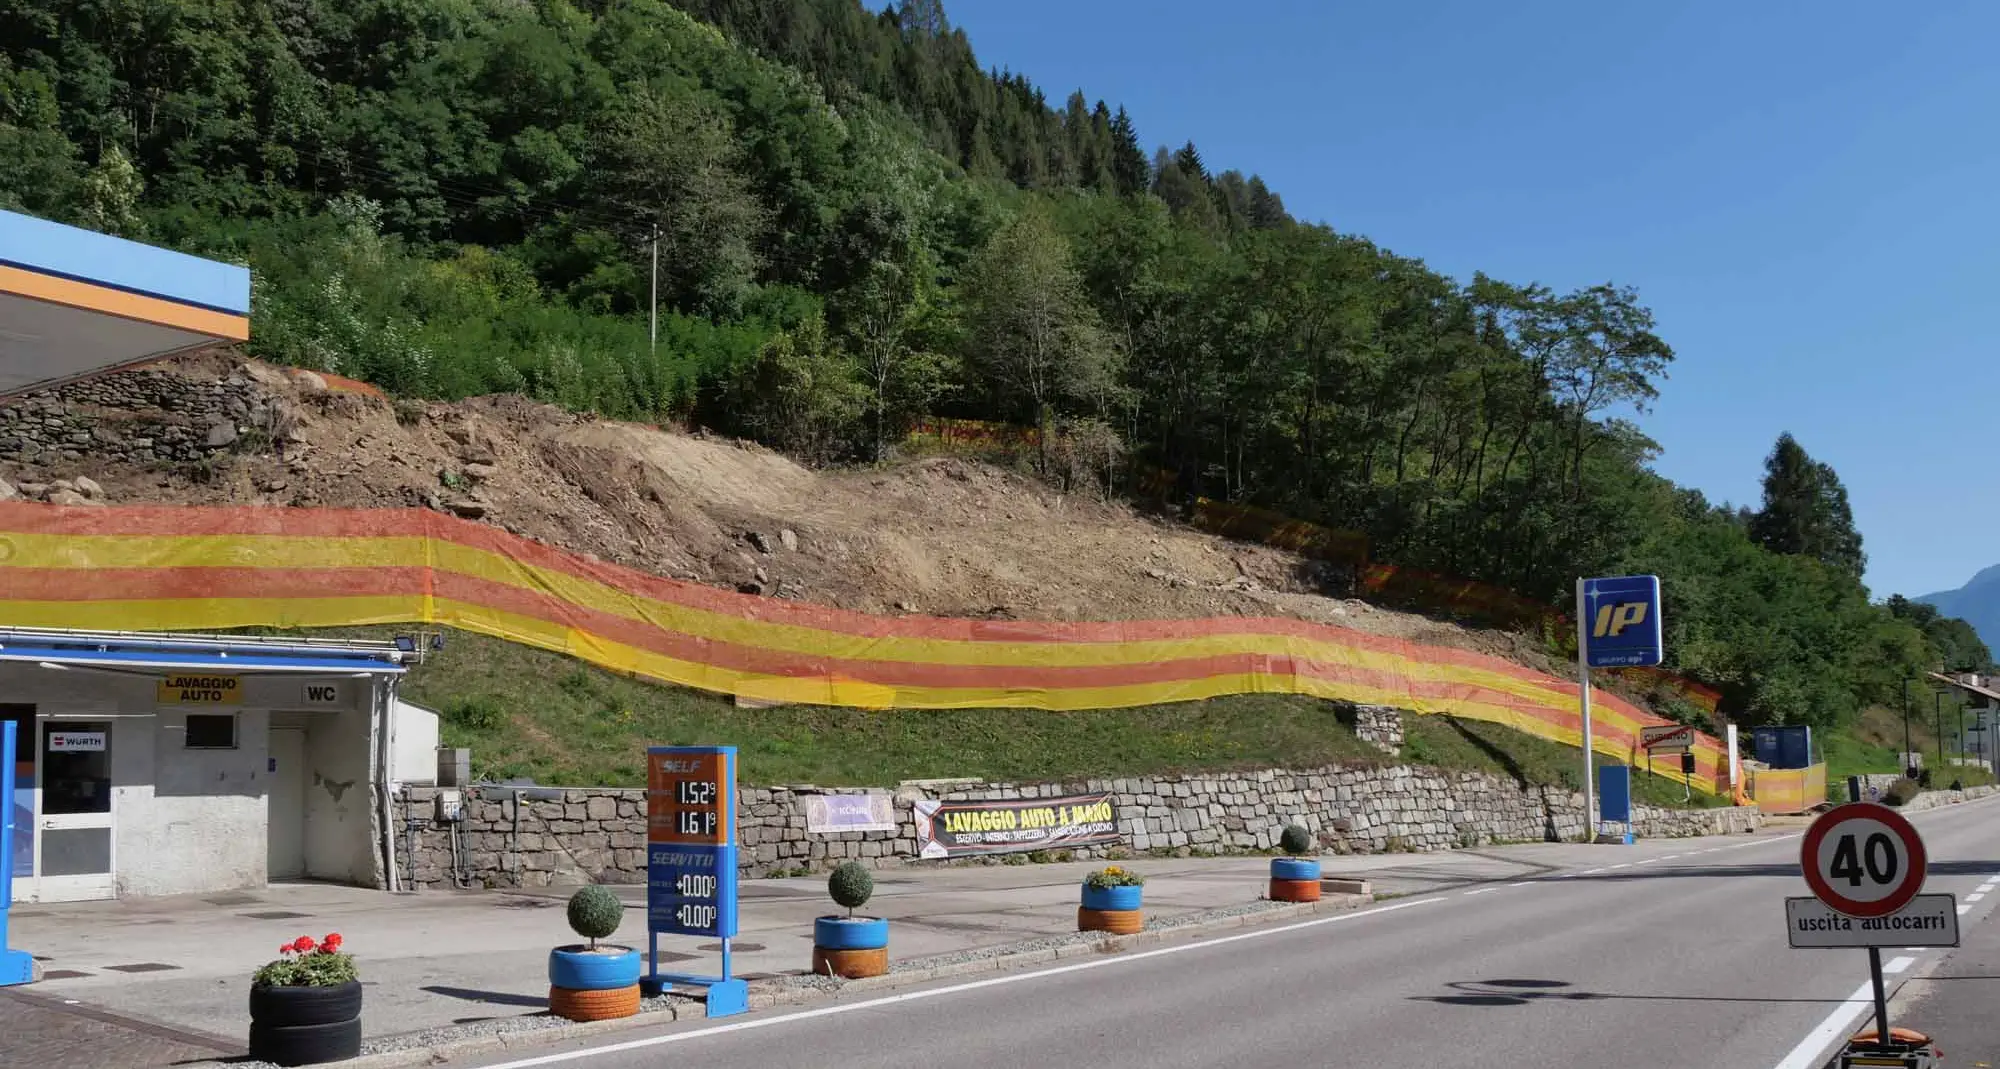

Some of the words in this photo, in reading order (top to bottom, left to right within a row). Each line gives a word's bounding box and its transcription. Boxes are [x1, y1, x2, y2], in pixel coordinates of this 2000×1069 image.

[1592, 602, 1648, 637] IP
[166, 677, 236, 689] LAVAGGIO
[181, 690, 222, 701] AUTO
[308, 686, 336, 701] WC
[663, 759, 702, 773] SELF
[944, 809, 1017, 833] LAVAGGIO
[1020, 807, 1056, 829] AUTO
[1059, 806, 1069, 826] A
[1072, 802, 1112, 824] MANO
[652, 851, 715, 867] SERVITO
[1830, 832, 1898, 887] 40
[1799, 912, 1852, 931] uscita
[1862, 911, 1946, 930] autocarri
